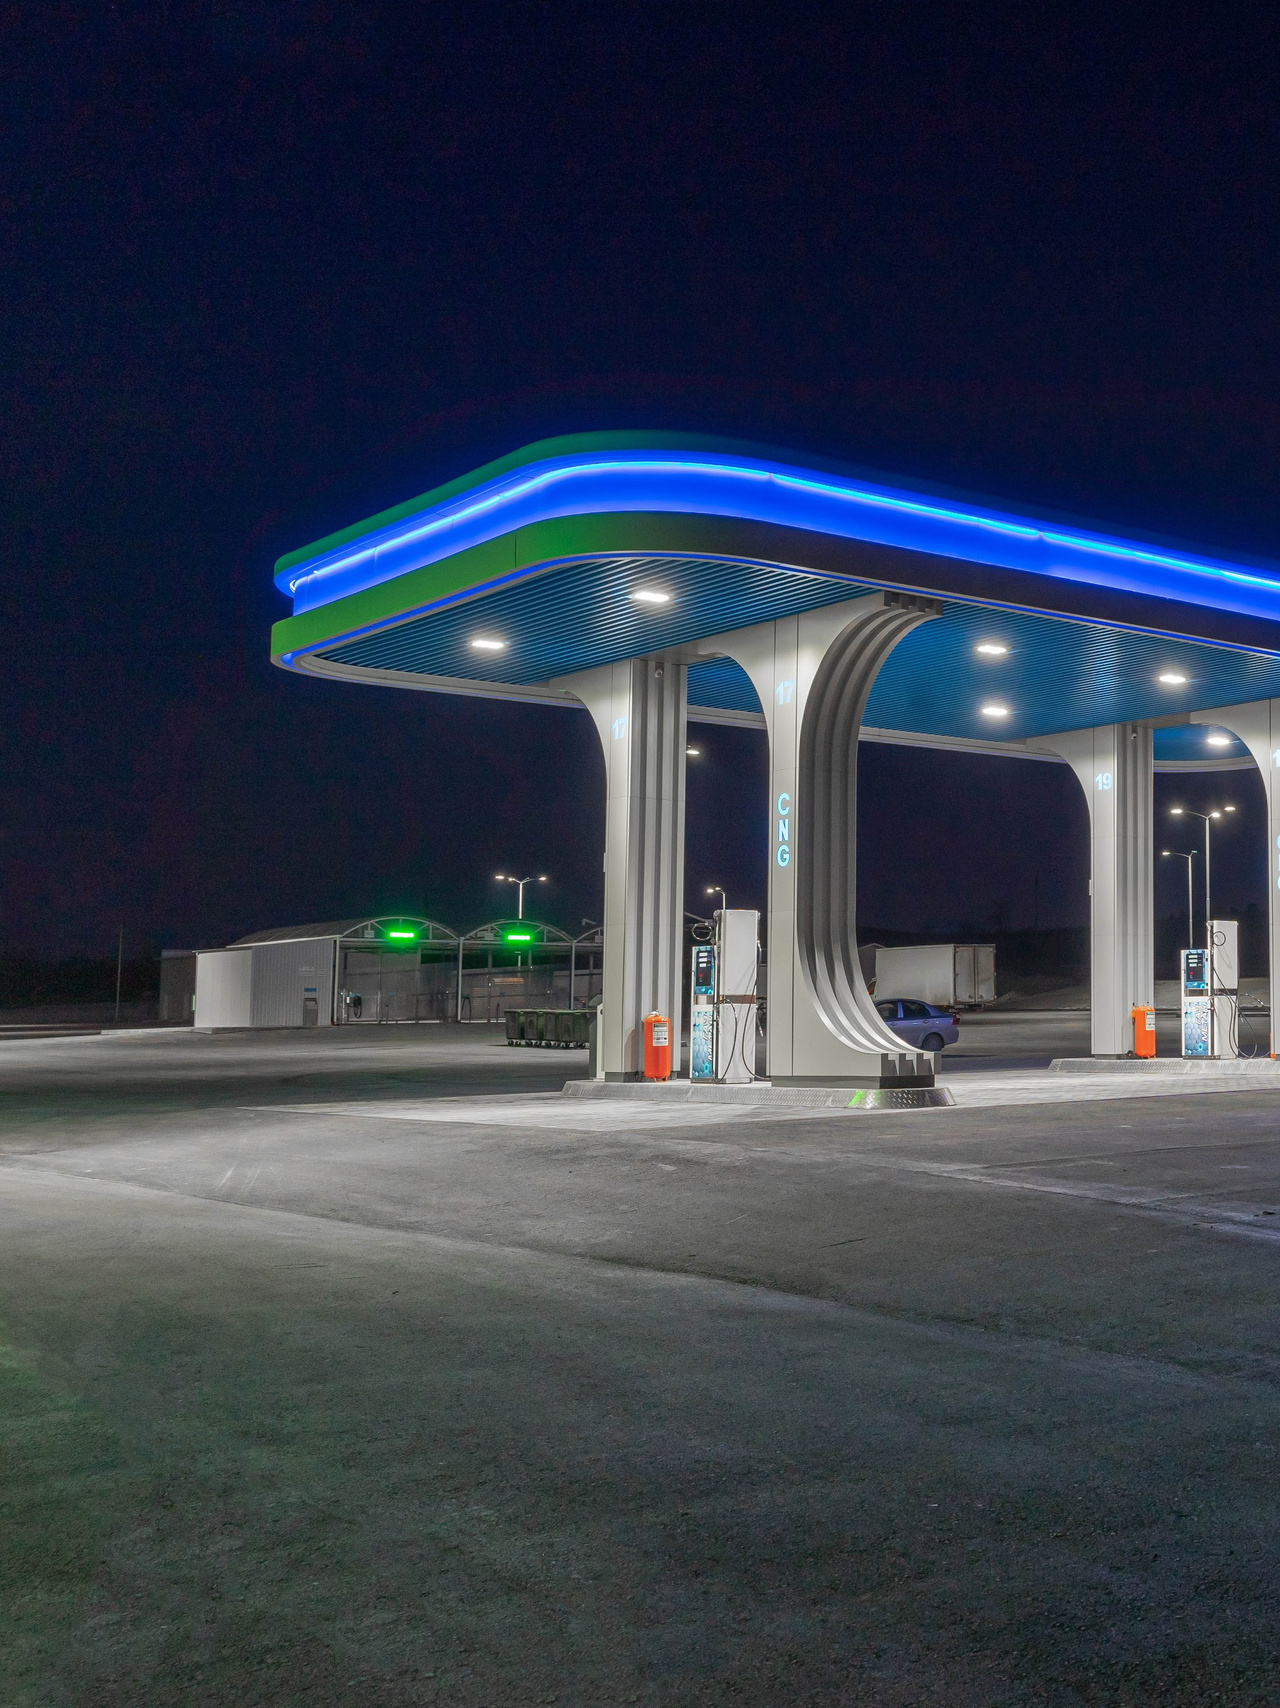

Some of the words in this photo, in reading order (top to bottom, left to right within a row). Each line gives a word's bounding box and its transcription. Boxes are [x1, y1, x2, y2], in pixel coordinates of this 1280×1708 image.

[774, 680, 795, 705] 17
[611, 716, 627, 740] 17
[1094, 772, 1113, 790] 19
[776, 792, 790, 868] CNG
